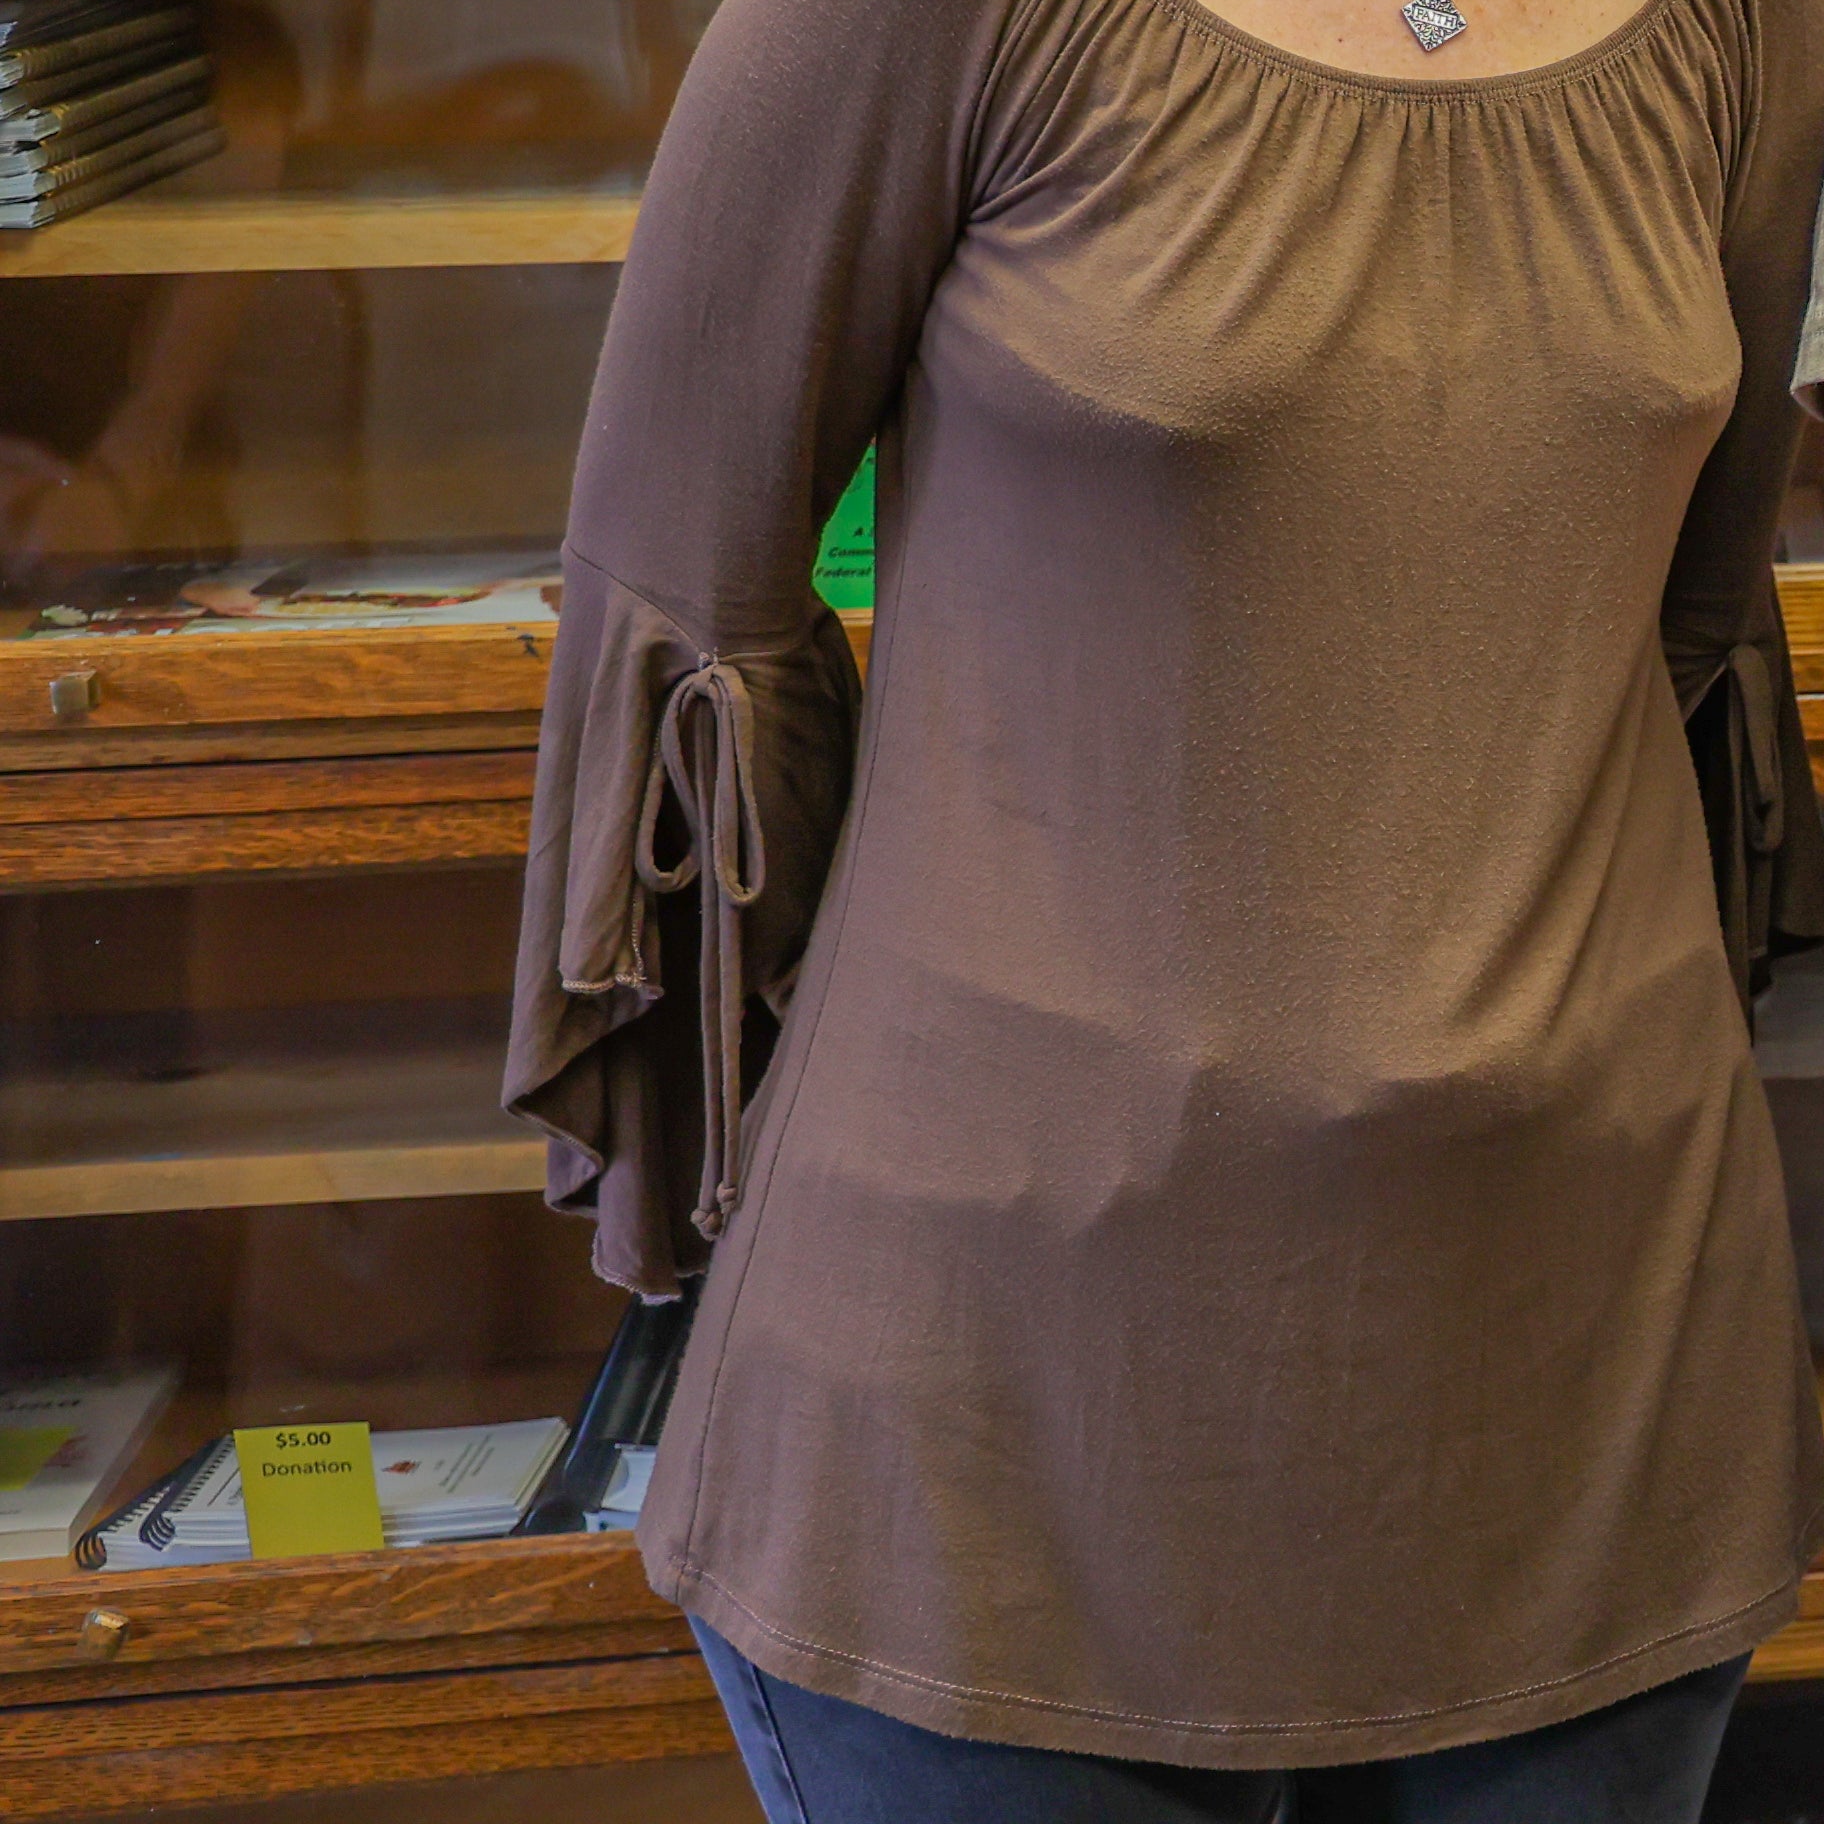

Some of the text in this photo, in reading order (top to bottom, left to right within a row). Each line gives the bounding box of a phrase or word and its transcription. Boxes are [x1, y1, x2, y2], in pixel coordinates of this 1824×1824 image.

[1415, 8, 1455, 27] FAITH
[274, 1431, 331, 1451] $5.00
[261, 1460, 352, 1478] Donation
